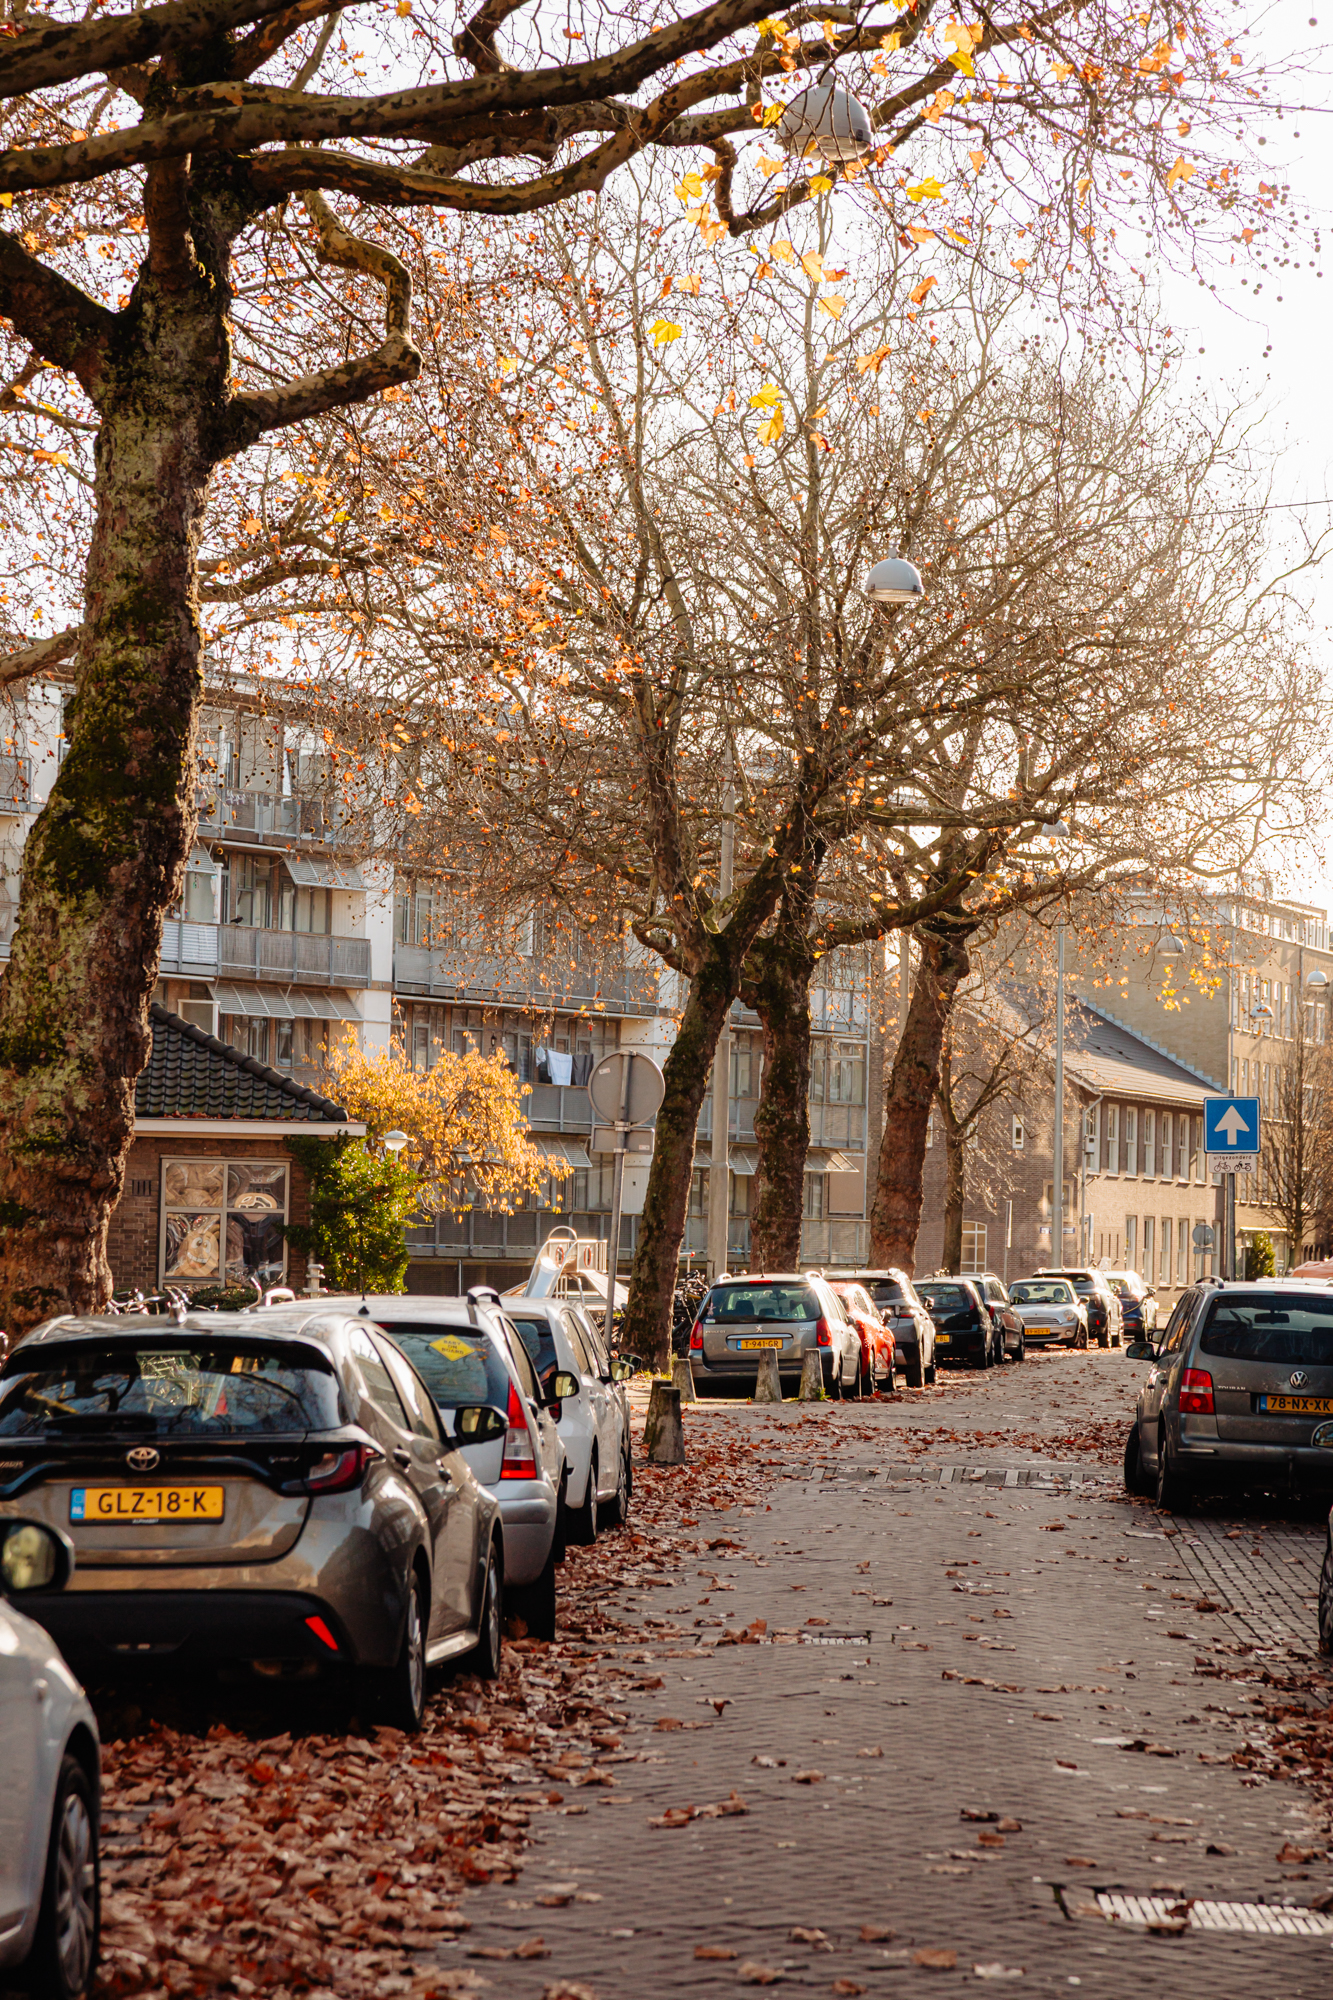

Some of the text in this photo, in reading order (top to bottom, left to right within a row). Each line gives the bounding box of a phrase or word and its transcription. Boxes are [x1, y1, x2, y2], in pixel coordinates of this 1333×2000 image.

[744, 1340, 779, 1348] T-941-GR
[1270, 1397, 1331, 1411] 78-NX-XK
[72, 1491, 207, 1515] NL GLZ-18-K
